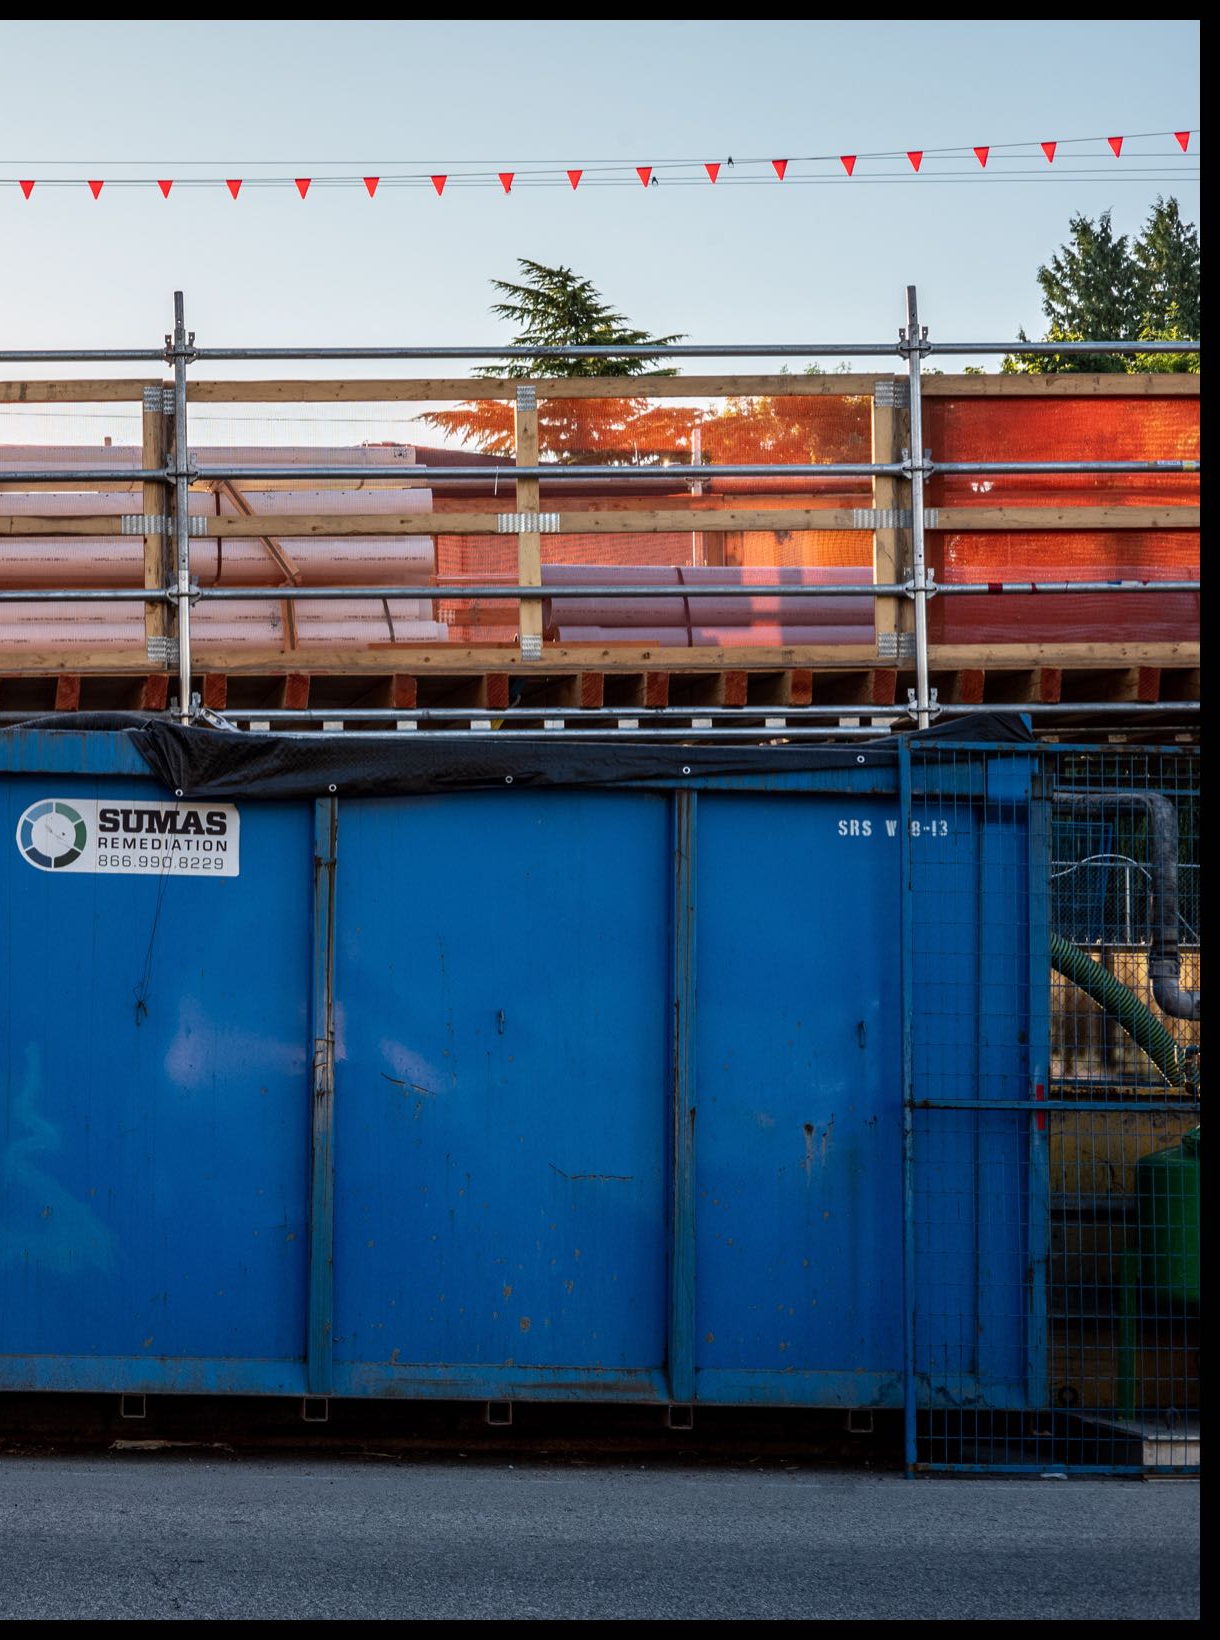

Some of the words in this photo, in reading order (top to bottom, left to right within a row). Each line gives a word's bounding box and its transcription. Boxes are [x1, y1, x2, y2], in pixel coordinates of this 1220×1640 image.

[98, 808, 227, 836] SUMAS
[838, 819, 872, 837] SRS
[97, 837, 228, 852] REMEDIATION
[97, 854, 224, 870] 866.990.8229
